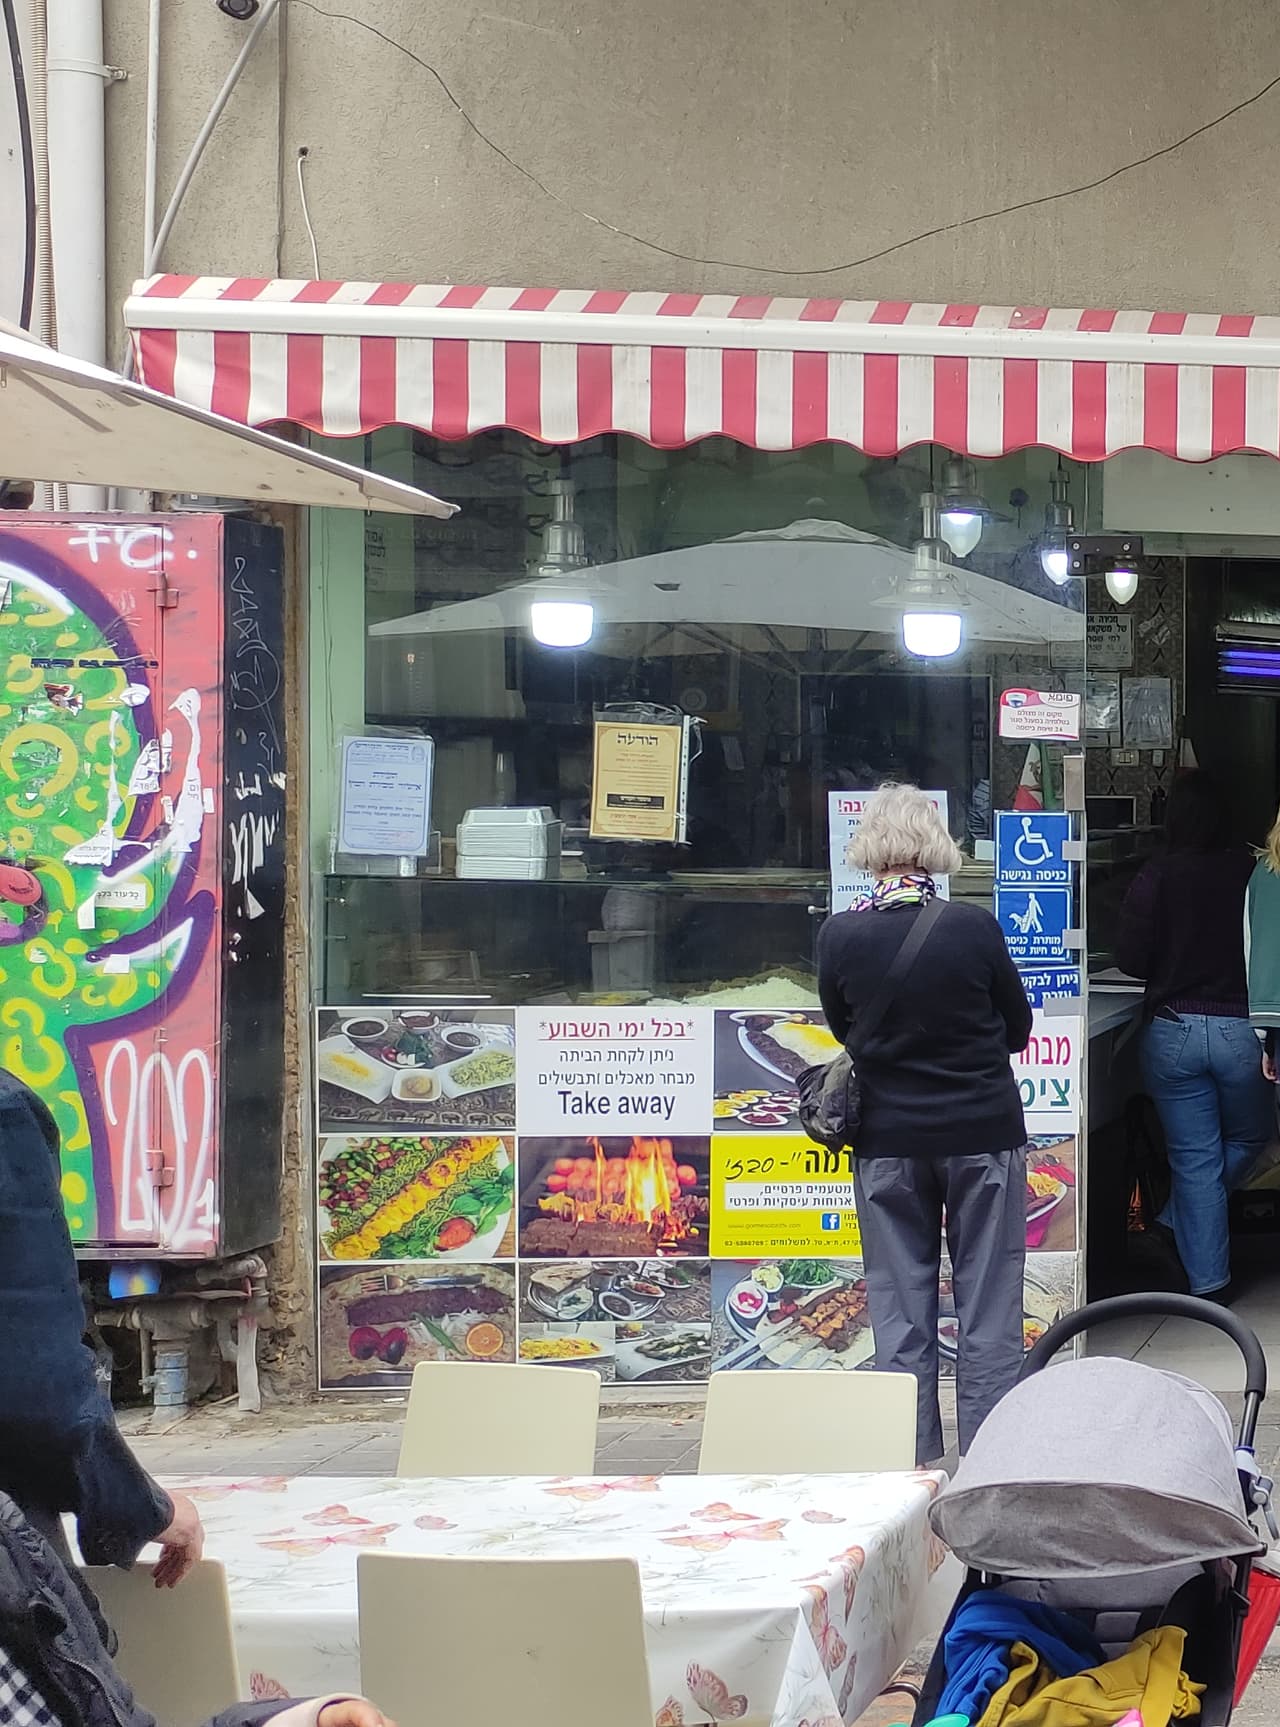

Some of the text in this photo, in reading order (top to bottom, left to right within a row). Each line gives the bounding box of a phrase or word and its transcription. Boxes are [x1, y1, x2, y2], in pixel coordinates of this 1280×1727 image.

[1001, 870, 1066, 880] כניסה נגישה
[1033, 936, 1060, 944] מותרת
[1052, 947, 1063, 955] עם
[1056, 973, 1079, 988] ניתן
[619, 1021, 645, 1037] ימי
[559, 1047, 674, 1064] ניתן לקחת הביתה
[538, 1070, 695, 1085] מבחר מאכלים ותבשילים
[558, 1090, 675, 1121] Take away
[806, 1184, 851, 1194] מטעמים
[764, 1197, 808, 1208] עיסקיות
[813, 1197, 852, 1207] ארוחות
